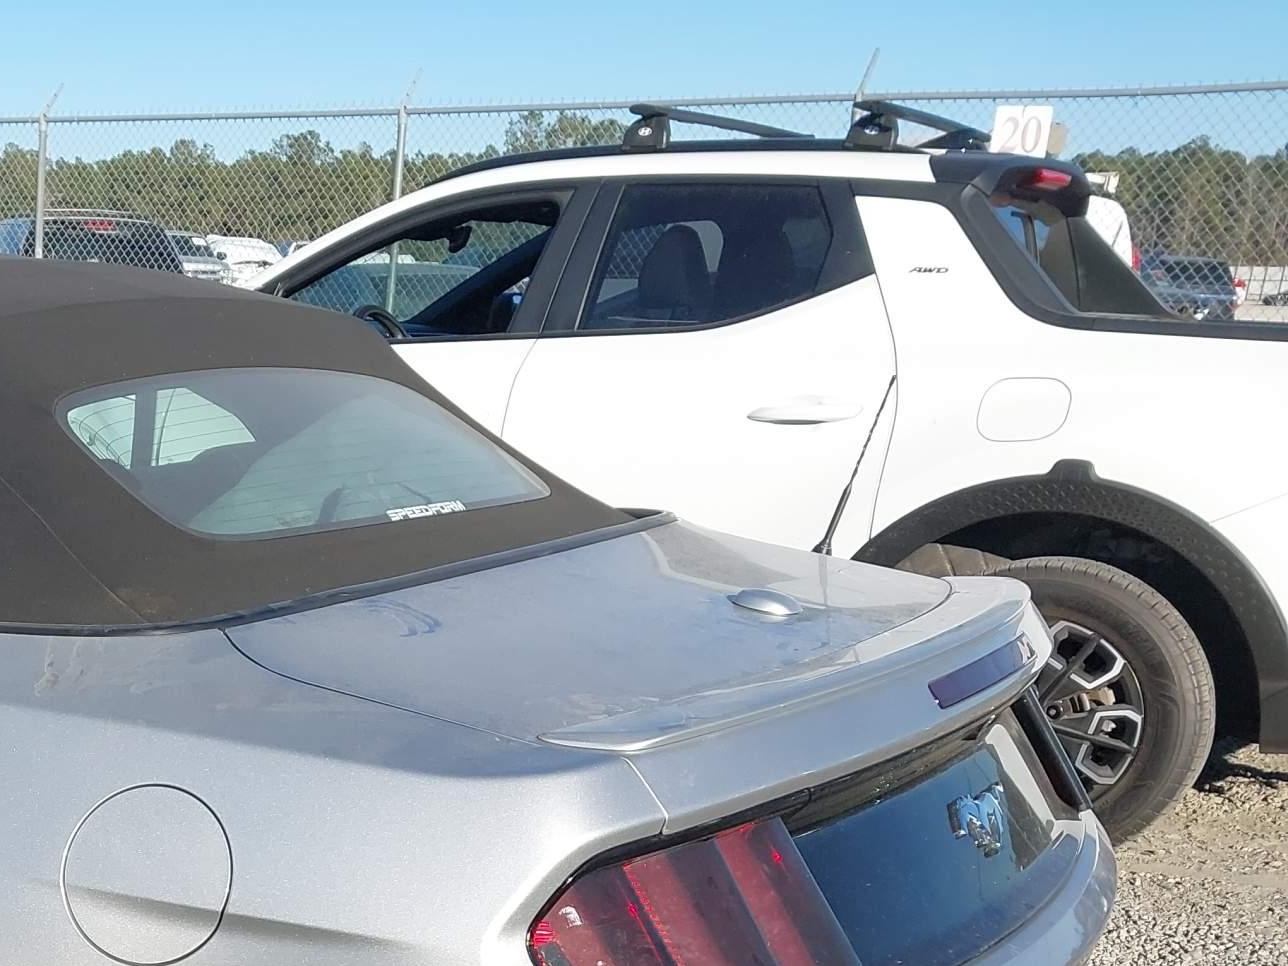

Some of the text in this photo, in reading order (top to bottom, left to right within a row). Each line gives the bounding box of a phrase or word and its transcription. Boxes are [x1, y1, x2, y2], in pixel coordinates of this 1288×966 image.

[998, 116, 1042, 153] 20
[908, 266, 950, 274] AWD
[385, 499, 467, 522] SPEEDFORM
